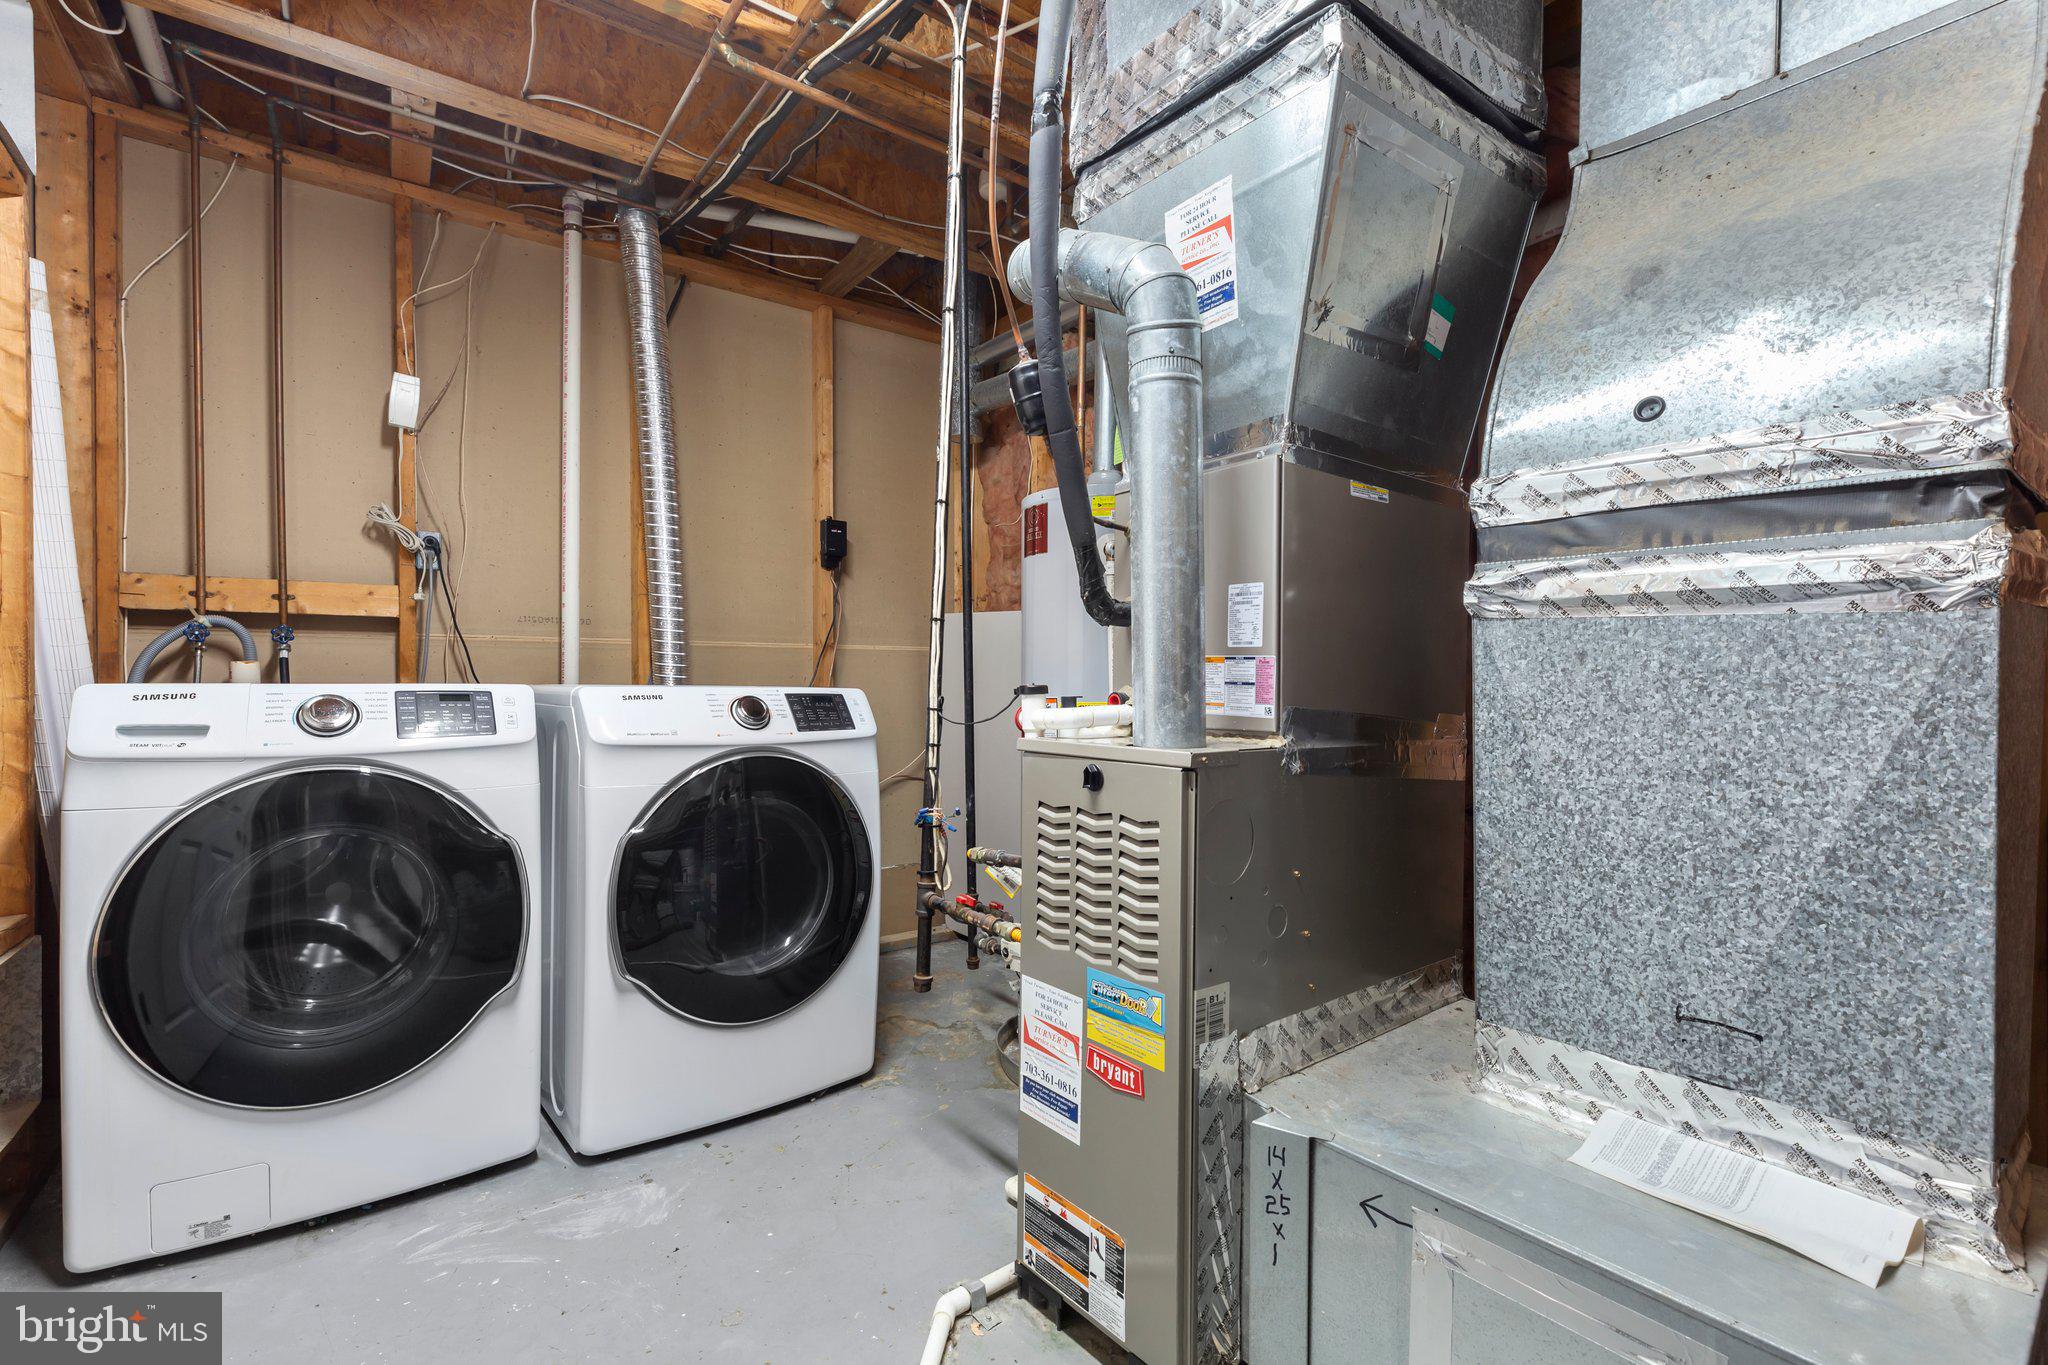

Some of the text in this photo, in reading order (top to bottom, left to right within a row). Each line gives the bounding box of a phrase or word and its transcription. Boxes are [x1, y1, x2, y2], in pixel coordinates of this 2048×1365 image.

[1180, 213, 1217, 238] PLEASE CALL
[1185, 208, 1210, 225] SERVICE
[131, 692, 197, 701] SAMSUNG
[1040, 1002, 1062, 1016] SERVICE
[1209, 994, 1219, 1003] B1
[1034, 1008, 1053, 1023] PLEASE
[1034, 1026, 1068, 1048] TURNER'S
[1024, 1061, 1078, 1098] 703-361-0816
[1093, 1052, 1135, 1089] bryant
[1268, 1145, 1286, 1166] 14
[1265, 1193, 1291, 1215] 25
